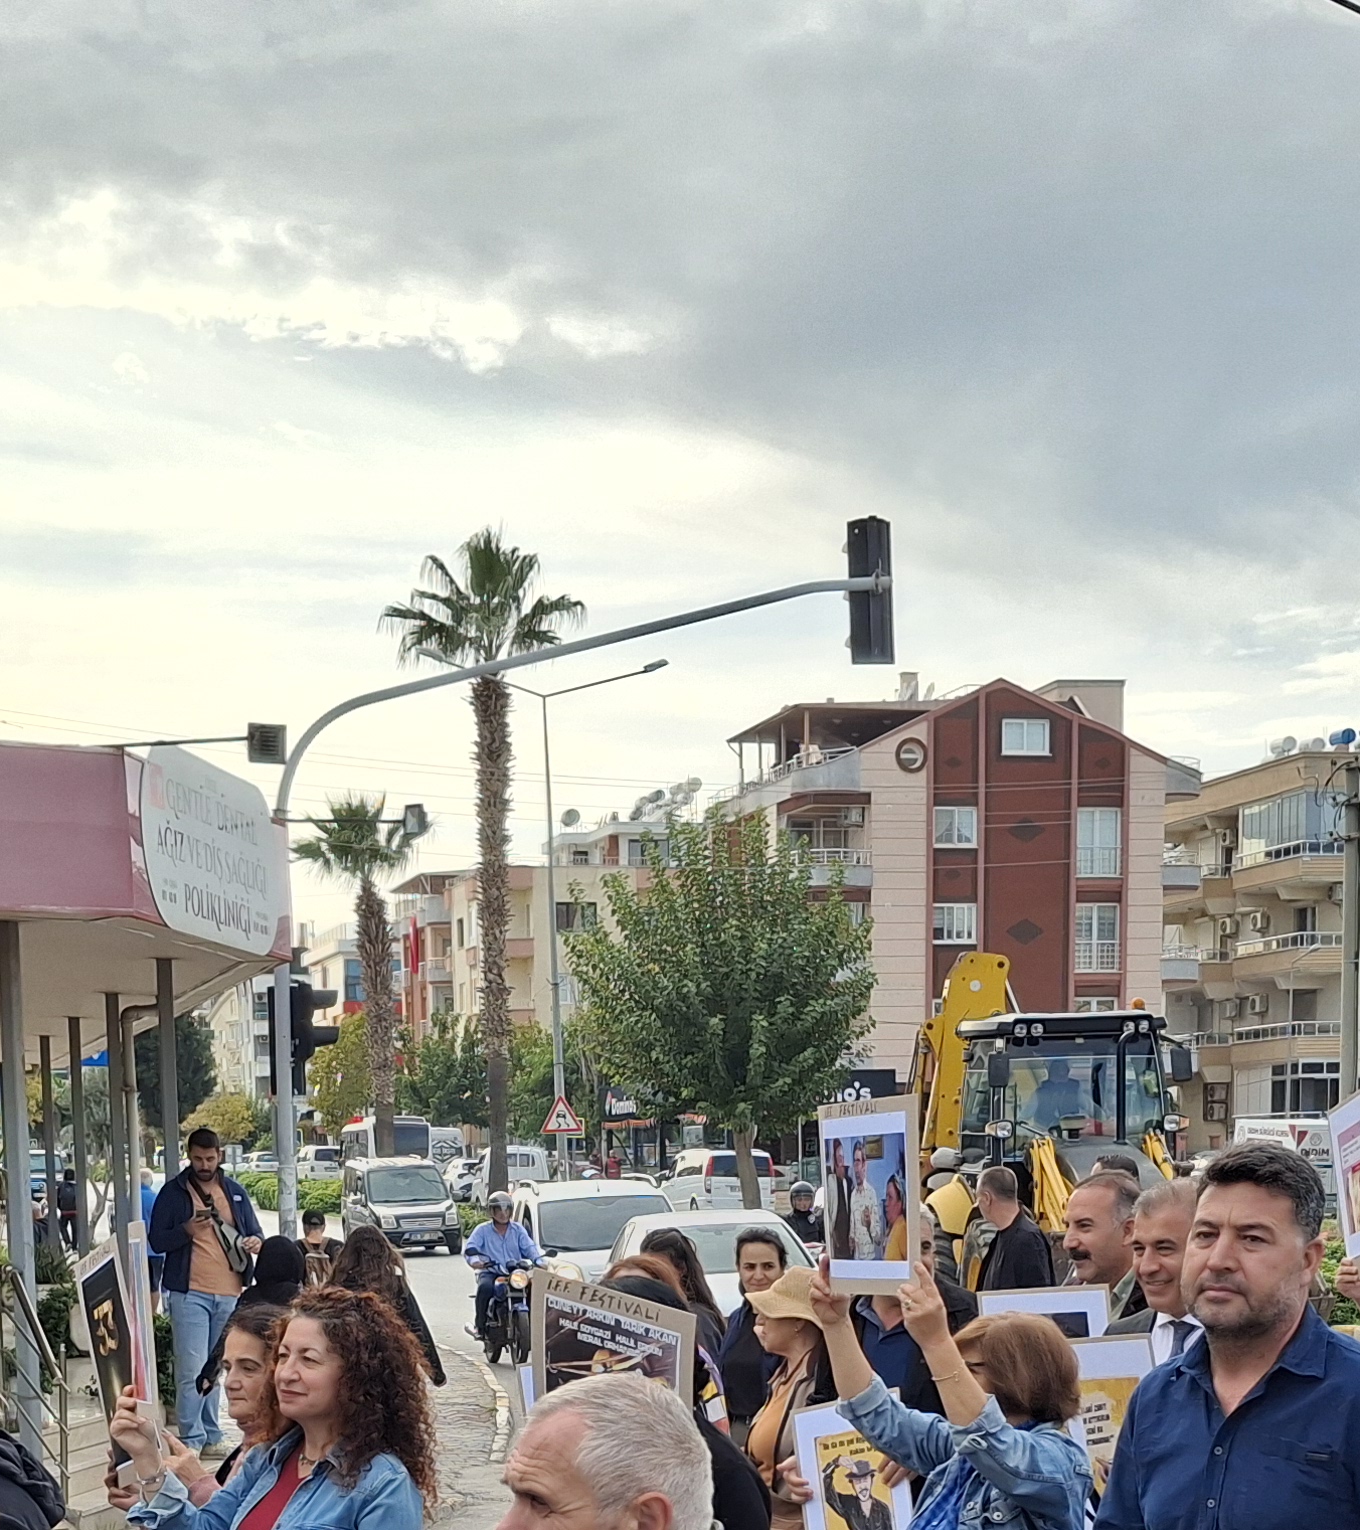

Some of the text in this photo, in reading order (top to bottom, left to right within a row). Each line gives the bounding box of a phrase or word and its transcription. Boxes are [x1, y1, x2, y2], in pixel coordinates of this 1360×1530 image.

[157, 818, 186, 868] AĞIZ
[187, 834, 203, 870] VE
[224, 850, 268, 901] SAĞLIĞI
[183, 882, 252, 942] POLİKLİNİĞİ
[1300, 1147, 1330, 1158] DİDİM
[647, 1327, 678, 1346] AKAN
